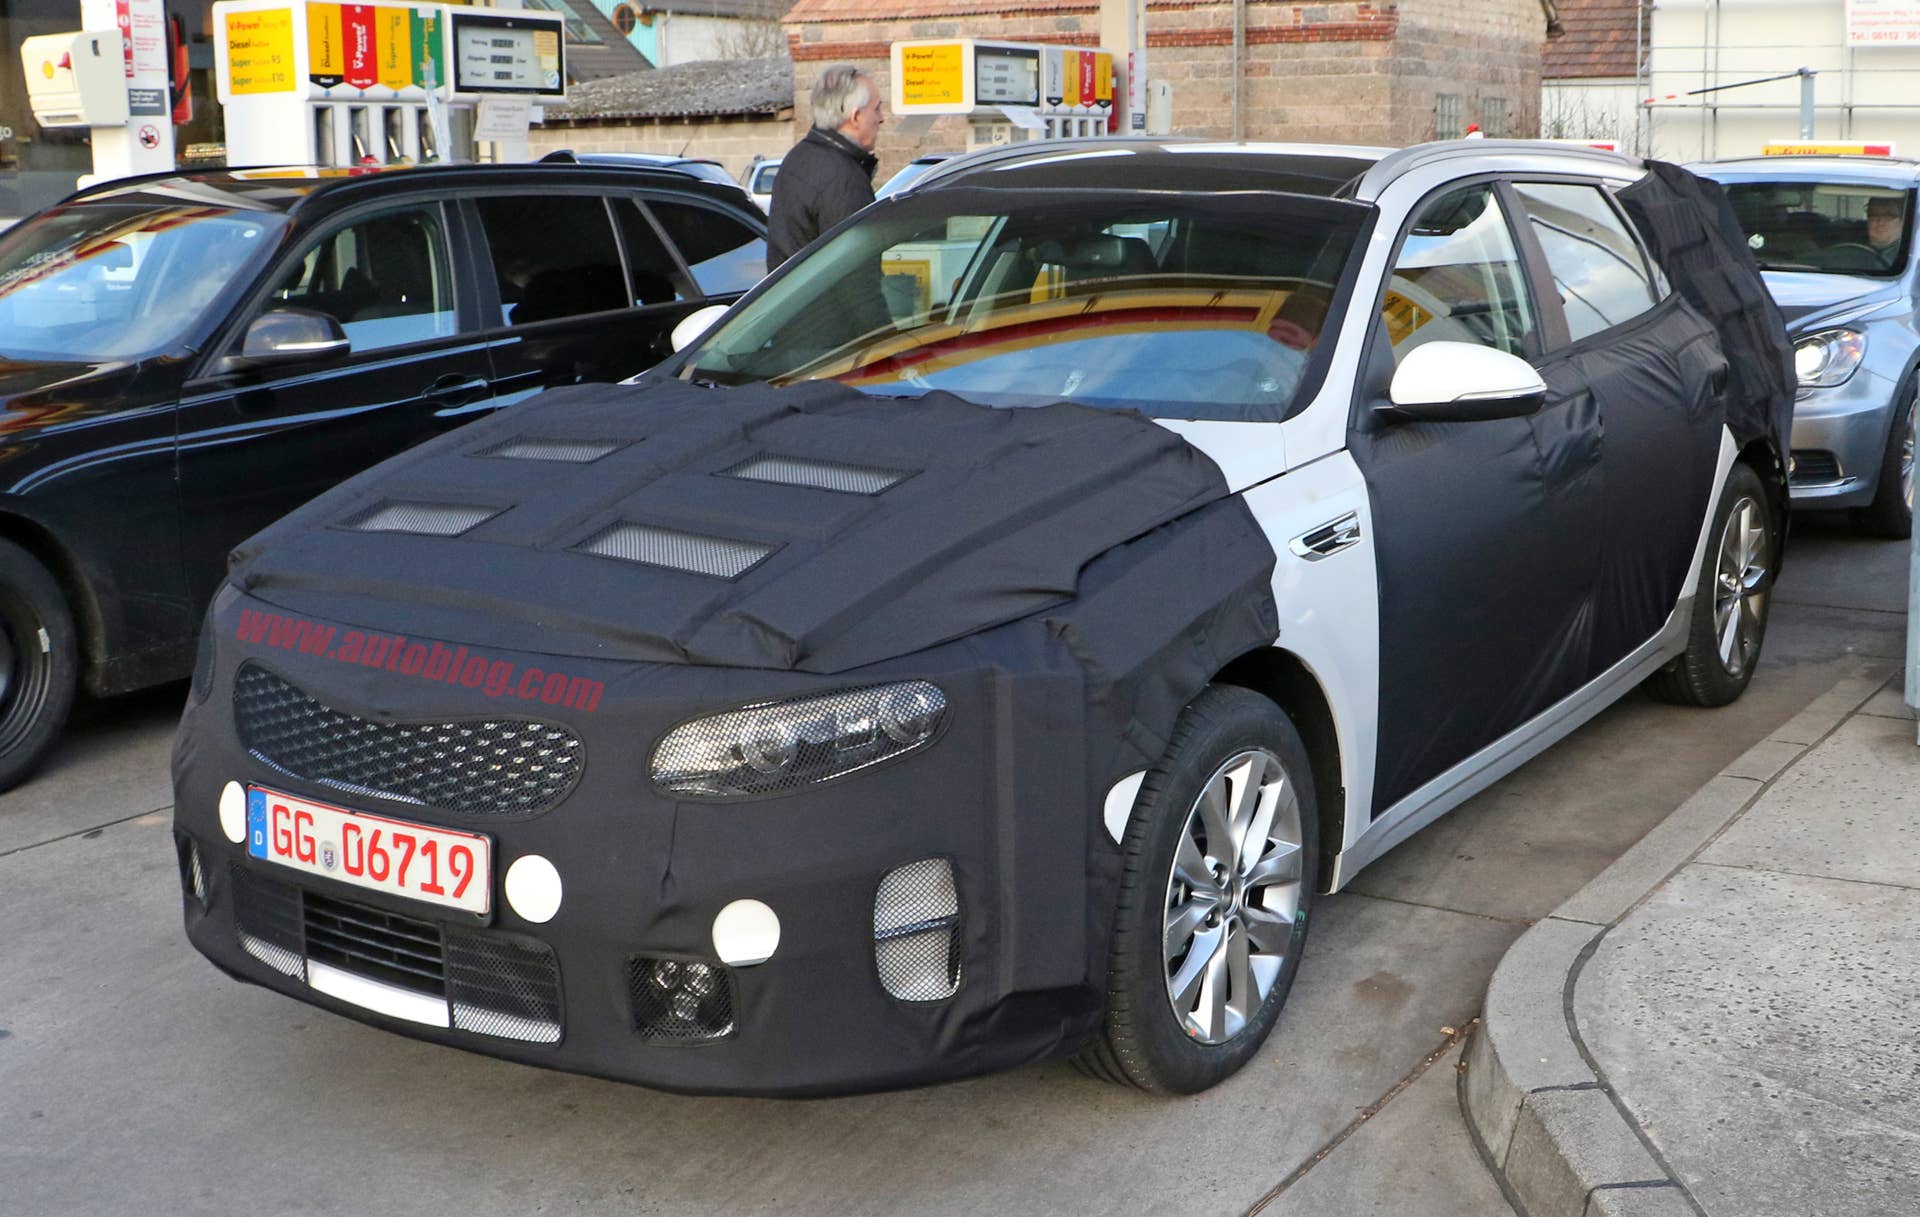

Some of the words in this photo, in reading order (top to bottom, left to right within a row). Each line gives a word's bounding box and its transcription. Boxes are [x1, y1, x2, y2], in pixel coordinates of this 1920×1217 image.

[230, 38, 251, 50] Diesel
[352, 22, 364, 69] V-Power
[255, 830, 263, 846] D
[272, 804, 317, 865] GG
[342, 822, 474, 899] 06719
